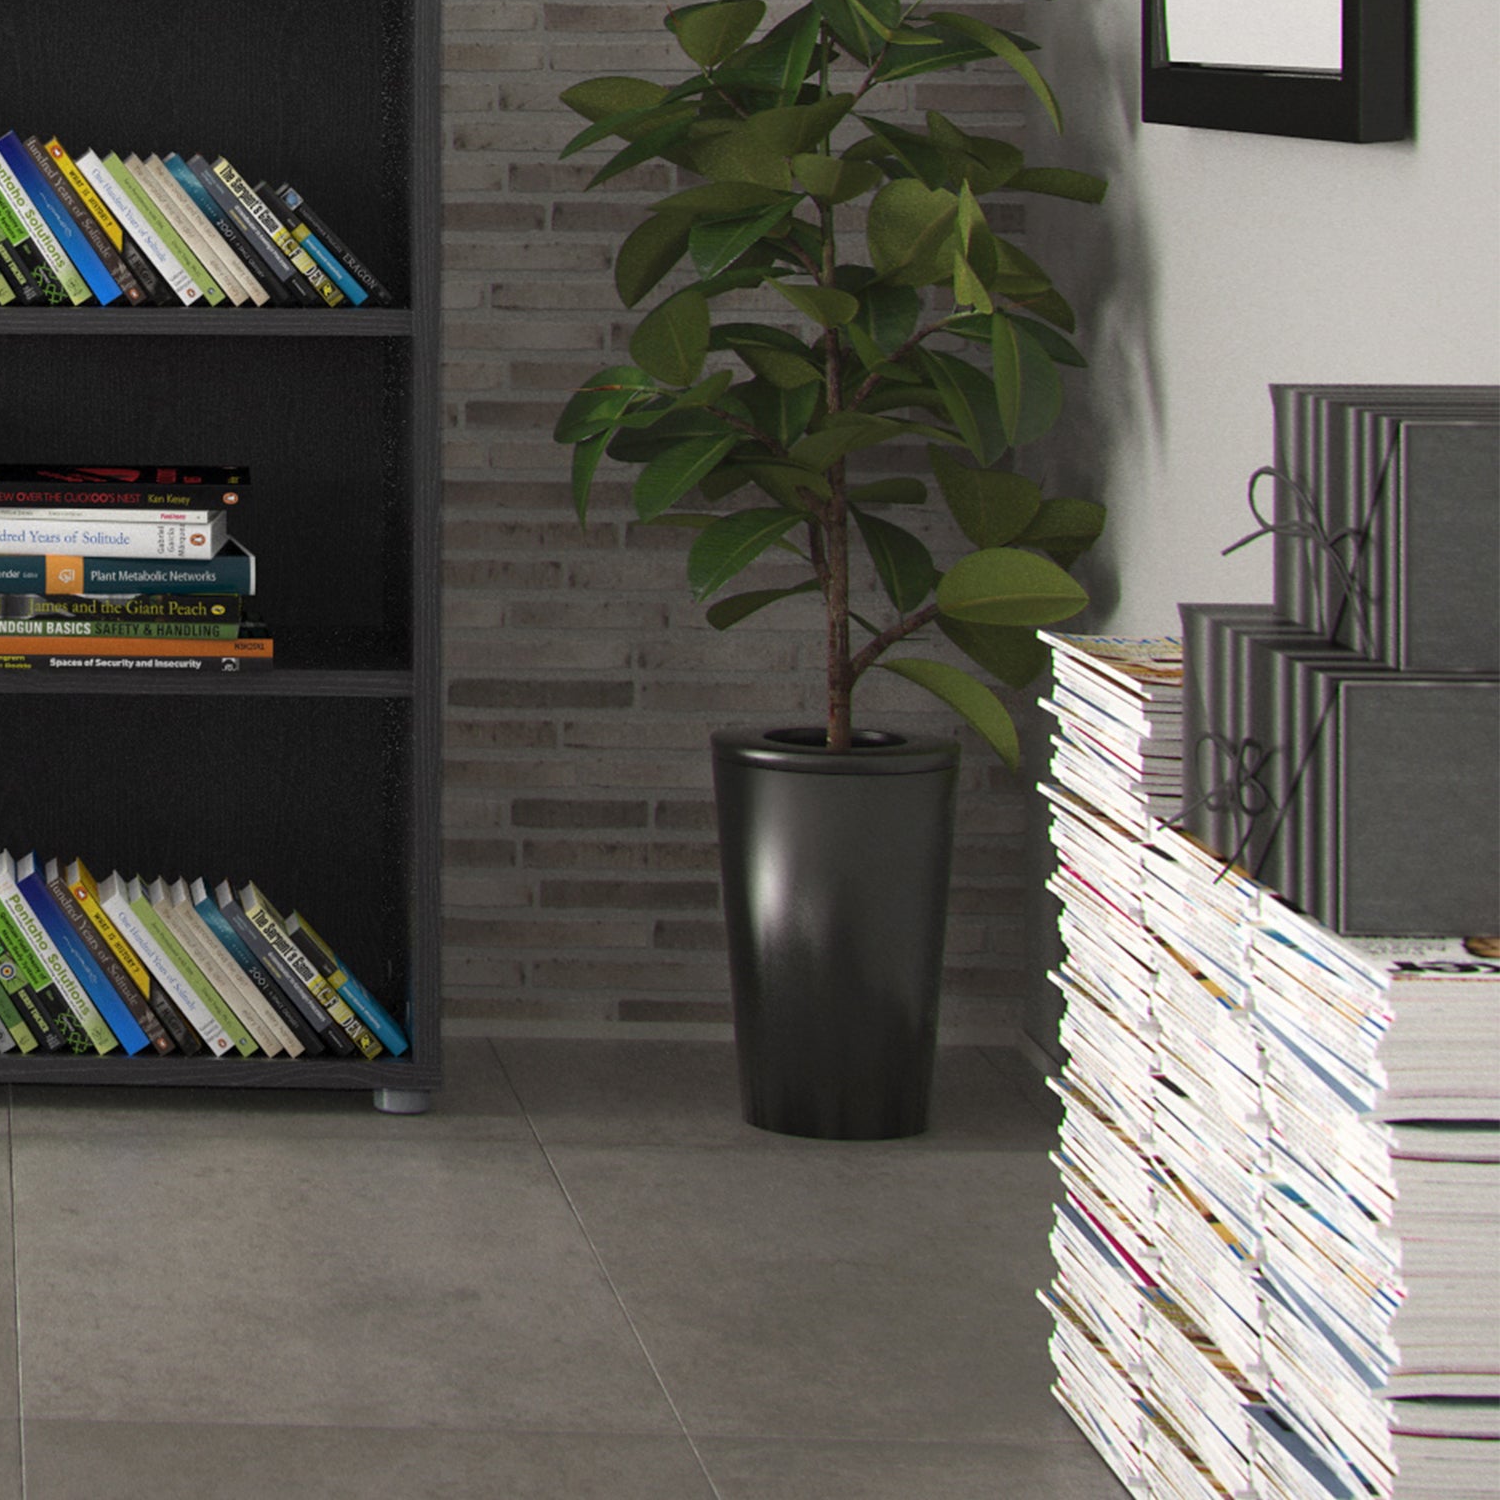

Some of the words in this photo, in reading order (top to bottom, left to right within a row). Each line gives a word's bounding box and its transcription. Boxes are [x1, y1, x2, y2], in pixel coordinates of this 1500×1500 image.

[218, 164, 237, 183] The
[228, 176, 266, 217] Serpent's
[23, 207, 68, 270] Solutions
[52, 176, 79, 207] Years
[80, 216, 114, 260] Solitude
[29, 529, 61, 545] Years
[64, 530, 79, 545] of
[81, 531, 131, 546] Solitude
[90, 569, 117, 582] Plant
[118, 569, 168, 582] Metabolic
[169, 570, 217, 583] Networks
[46, 621, 91, 635] BASICS
[94, 622, 140, 637] SAFETY
[143, 623, 153, 637] &
[156, 623, 221, 638] HANDLING
[72, 598, 97, 615] and
[101, 599, 122, 615] the
[126, 598, 165, 616] Giant
[169, 599, 207, 616] Peach
[49, 658, 84, 670] Spaces
[86, 658, 95, 669] of
[94, 658, 134, 670] Security
[135, 658, 153, 669] and
[154, 659, 202, 670] Insecurity
[7, 892, 51, 953] Pentaho
[46, 951, 93, 1017] Solutions
[250, 908, 271, 928] The
[261, 920, 301, 964] Serpent's
[76, 919, 104, 952] Years
[105, 961, 141, 1008] Solitude
